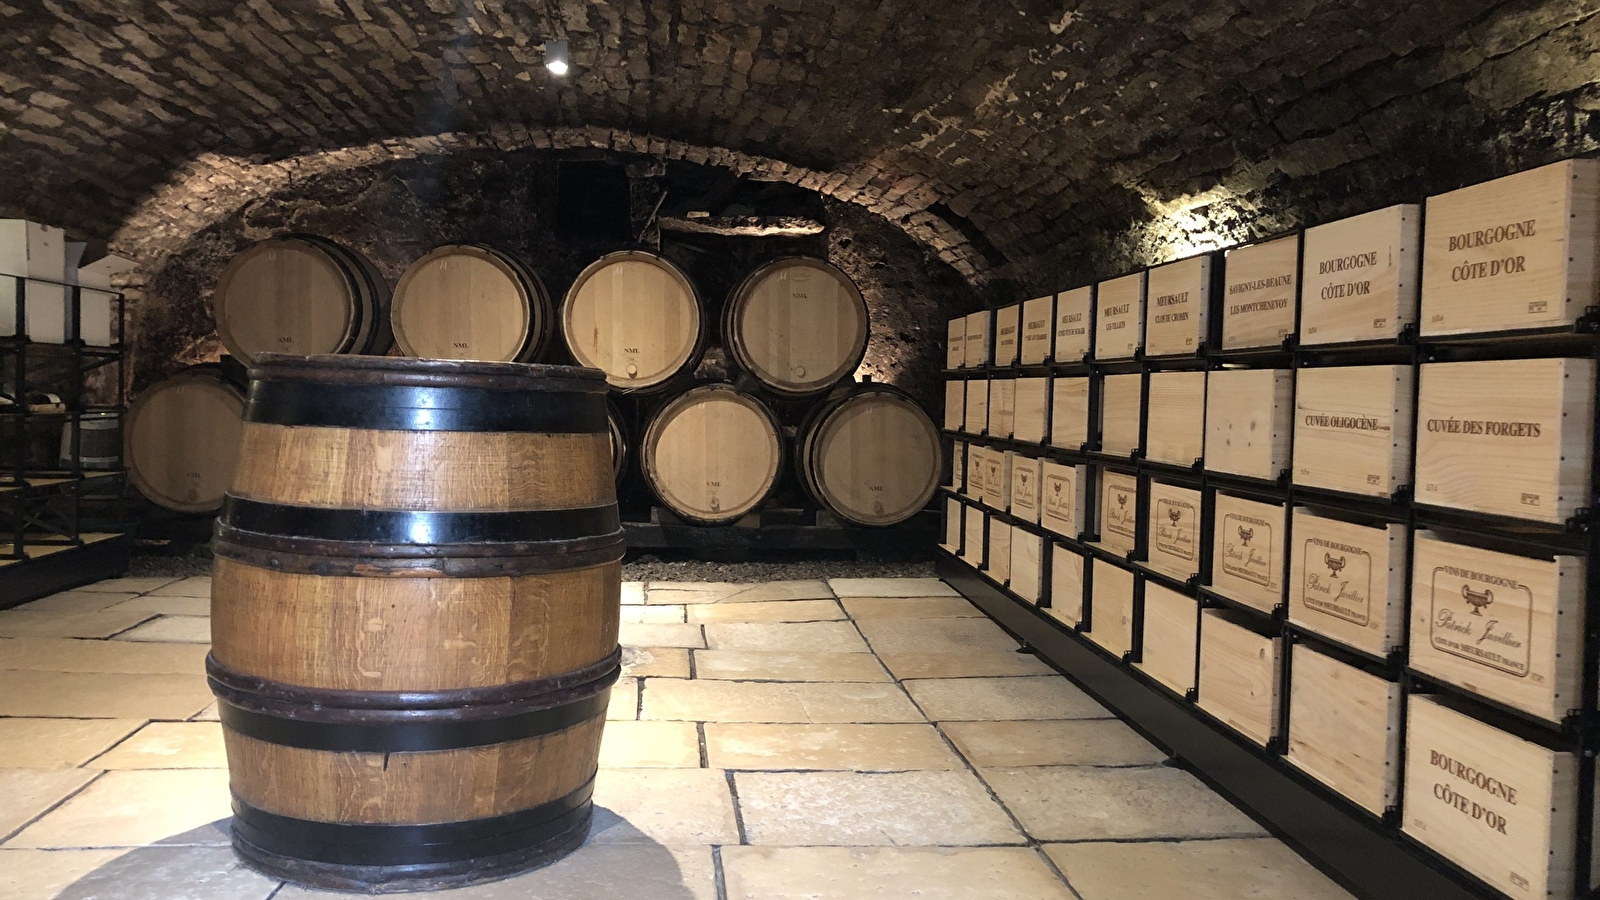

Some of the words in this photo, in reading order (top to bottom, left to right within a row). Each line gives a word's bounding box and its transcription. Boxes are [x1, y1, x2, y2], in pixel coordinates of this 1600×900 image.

[1448, 219, 1536, 252] BOURGOGNE
[1319, 251, 1378, 275] BOURGOGNE
[1451, 260, 1488, 282] CÔTE
[1490, 255, 1526, 277] D'OR
[1228, 274, 1292, 295] SAVIGNY-LES-BEAUNE
[1321, 282, 1346, 300] CÔTE
[1347, 280, 1371, 298] D'OR
[1156, 291, 1190, 308] MEURSAULT
[1305, 413, 1330, 427] CUVÉE
[1330, 414, 1378, 431] OLIGOCÈNE
[1427, 416, 1461, 434] CUVÉE
[1463, 421, 1483, 435] DES
[1485, 421, 1541, 438] FORGETS
[1444, 565, 1460, 576] VINS
[1460, 568, 1470, 578] DE
[1470, 571, 1518, 590] BOURGOGNE
[1435, 608, 1473, 635] Patrick
[1476, 619, 1522, 648] Javillier
[1429, 748, 1517, 806] BOURGOGNE
[1432, 783, 1470, 814] CÔTE
[1471, 801, 1508, 836] D'OR
